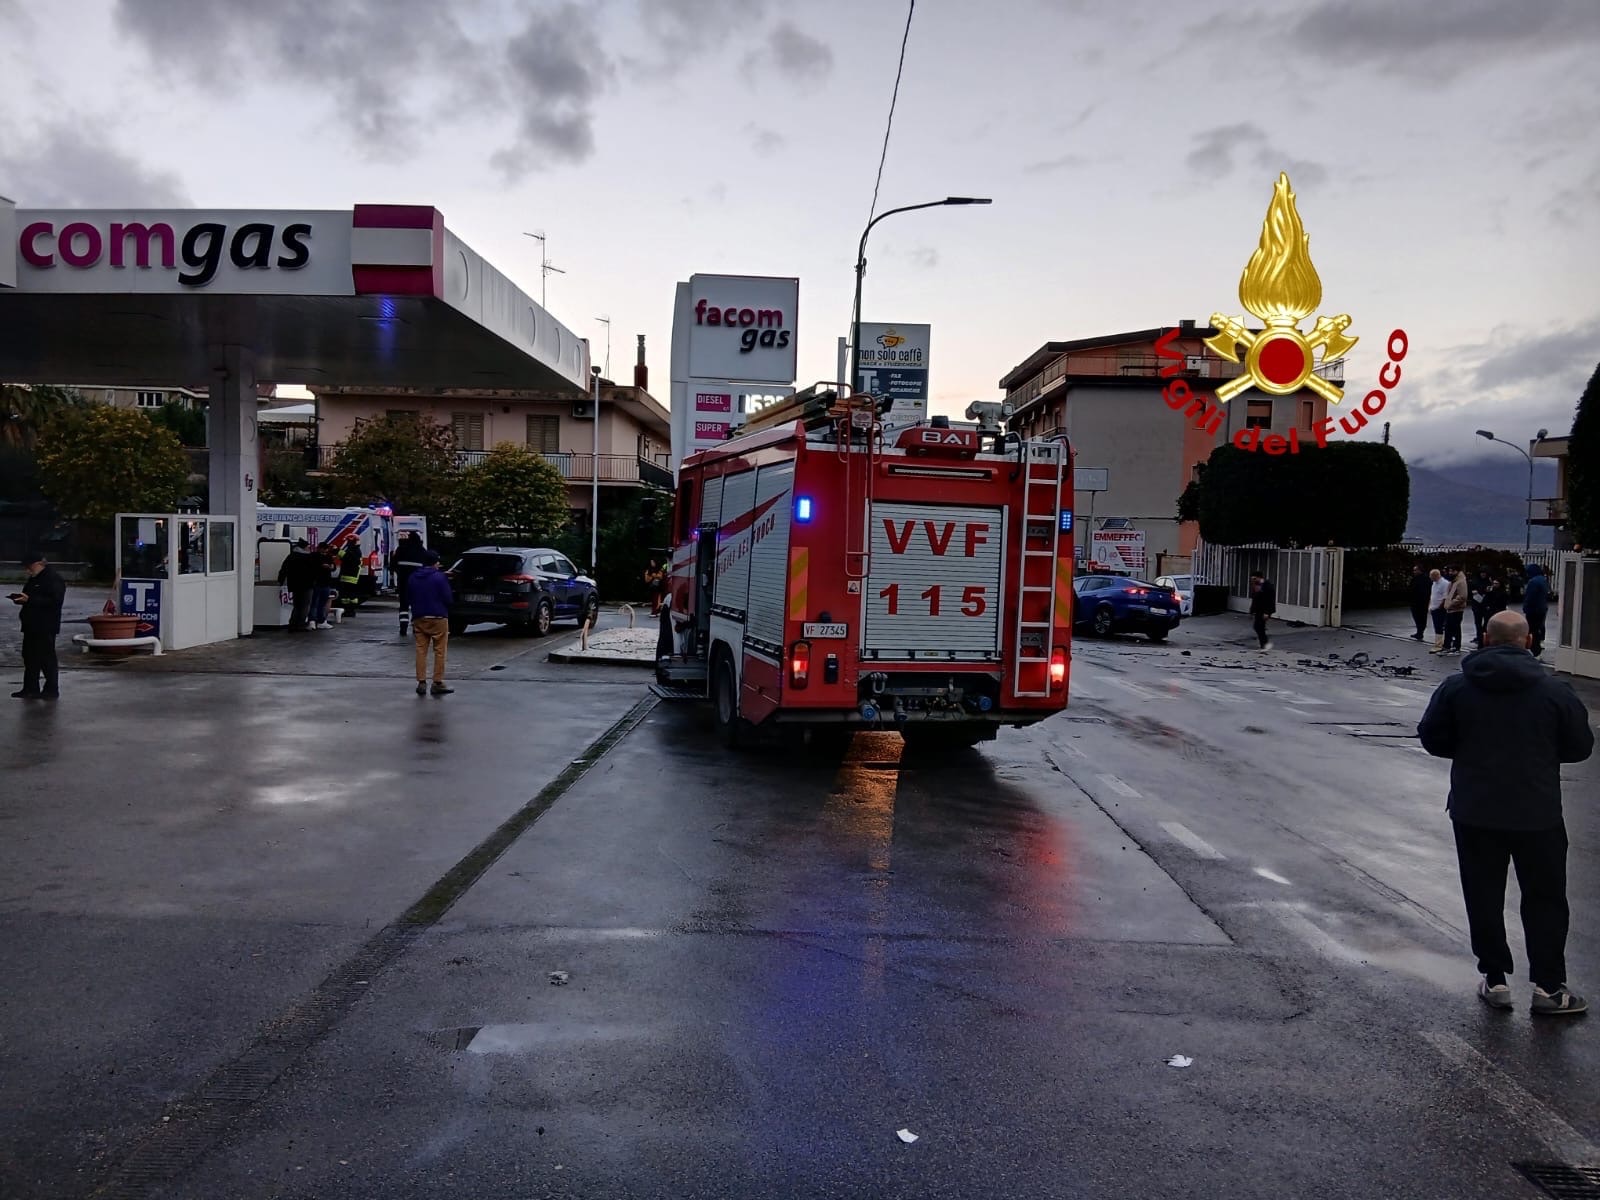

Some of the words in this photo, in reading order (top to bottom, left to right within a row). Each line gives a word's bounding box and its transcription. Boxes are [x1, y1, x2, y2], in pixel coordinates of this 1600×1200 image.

[19, 222, 312, 286] comgas
[694, 299, 783, 328] facom
[739, 328, 791, 353] gas
[877, 347, 896, 361] solo
[898, 348, 922, 362] caffè
[697, 395, 724, 405] DIESEL
[696, 423, 722, 432] SUPER
[922, 431, 970, 446] BAI
[256, 513, 273, 521] OCE
[882, 518, 989, 558] VVF
[128, 582, 154, 611] T
[805, 625, 816, 635] VF
[820, 625, 845, 635] 27345
